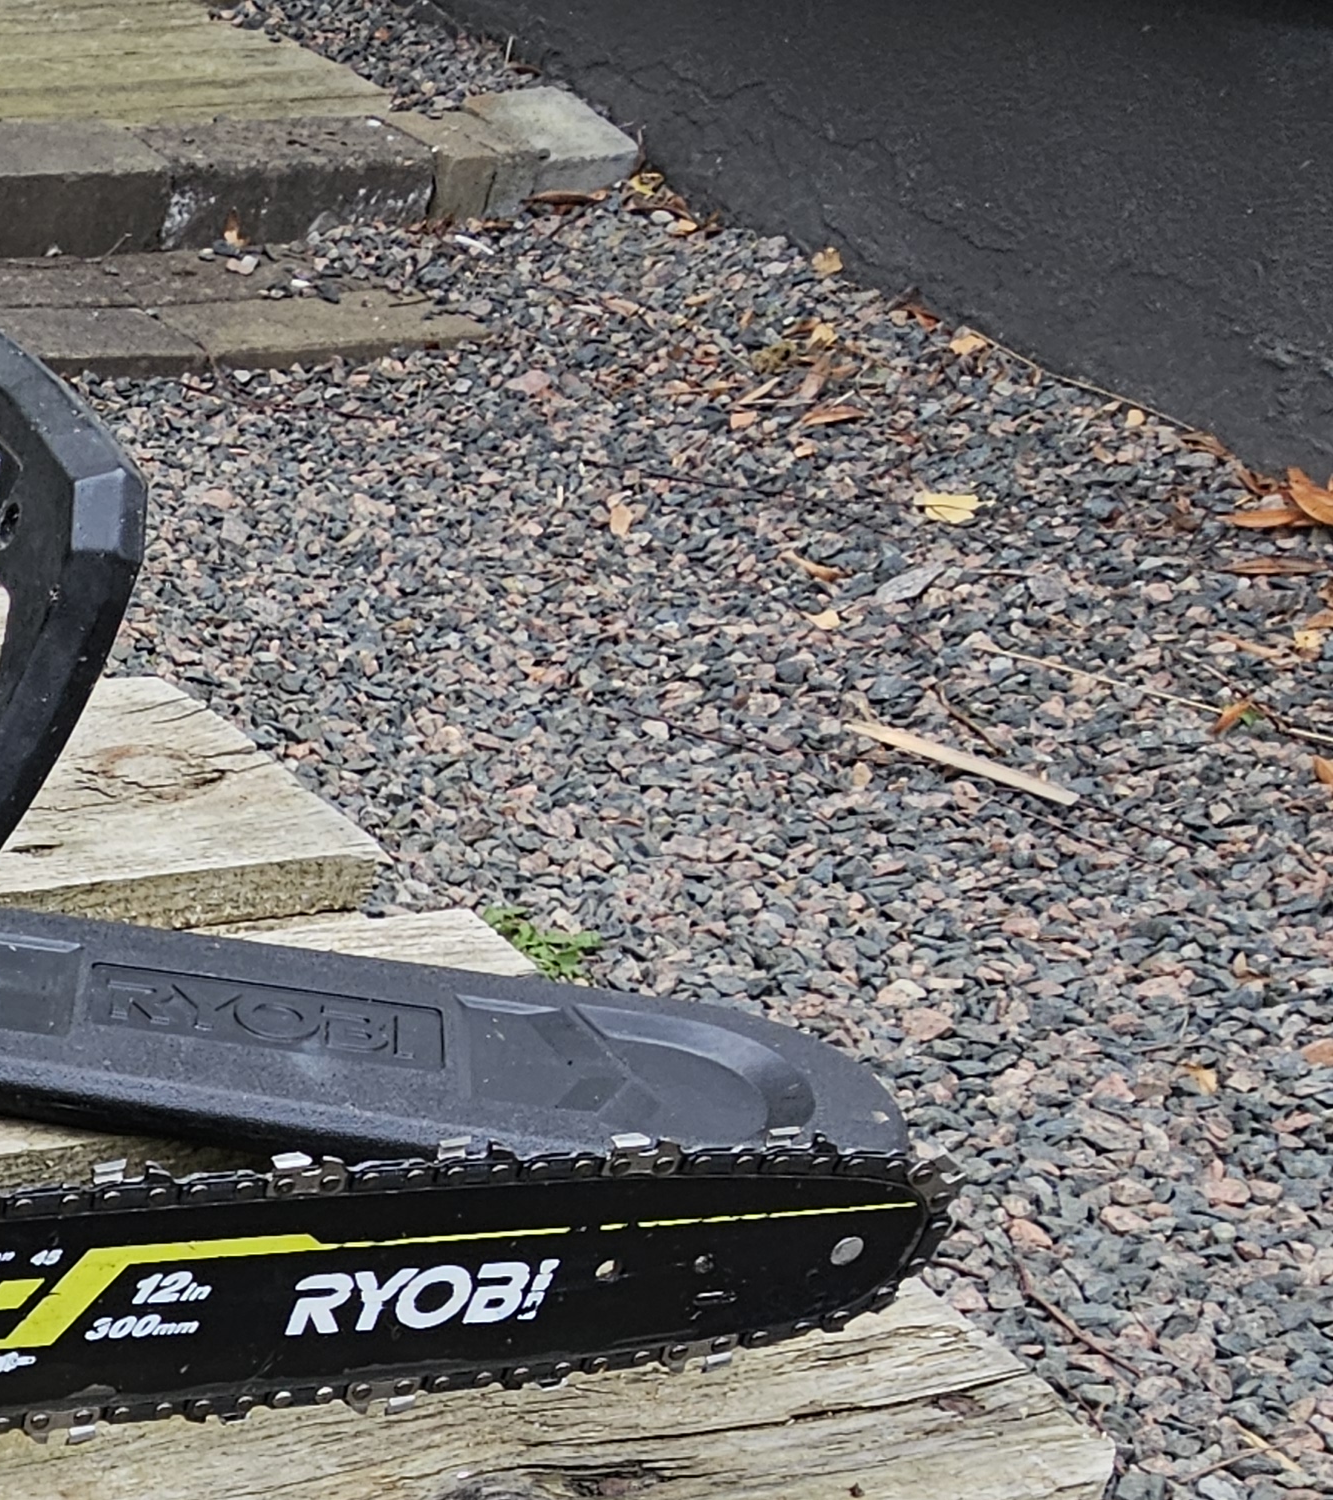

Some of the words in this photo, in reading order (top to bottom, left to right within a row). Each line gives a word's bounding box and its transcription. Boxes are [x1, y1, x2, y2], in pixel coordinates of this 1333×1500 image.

[105, 978, 416, 1062] RYOBI
[30, 1249, 64, 1266] 45
[132, 1271, 213, 1304] 12in
[285, 1258, 560, 1337] RYOBI
[85, 1314, 200, 1341] 300mm
